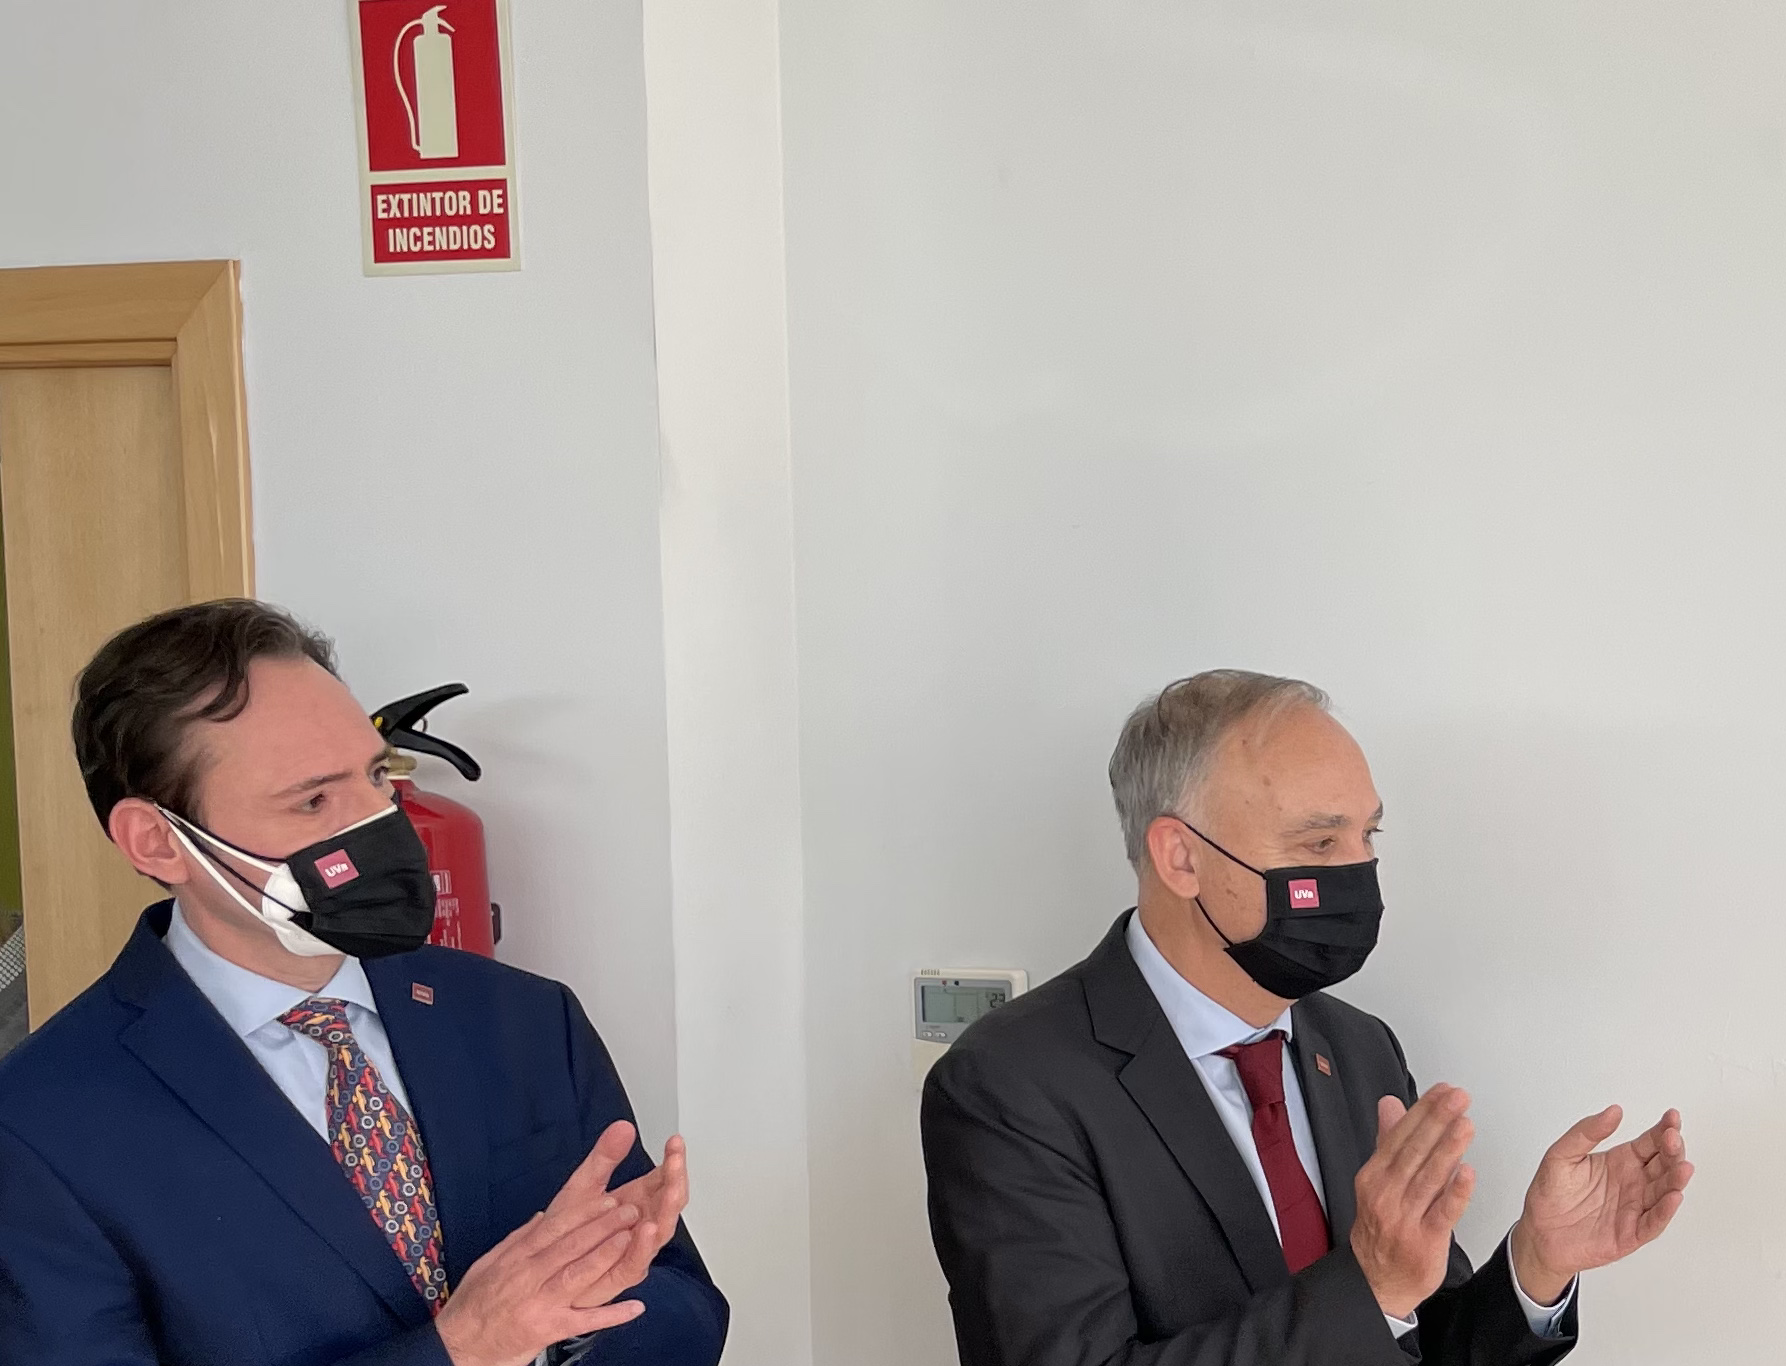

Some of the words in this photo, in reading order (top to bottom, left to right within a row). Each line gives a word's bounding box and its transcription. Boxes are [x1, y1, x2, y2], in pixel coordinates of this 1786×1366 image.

[376, 190, 472, 219] EXTINTOR
[478, 189, 504, 215] DE
[388, 224, 496, 253] INCENDIOS
[1294, 889, 1314, 900] UVa
